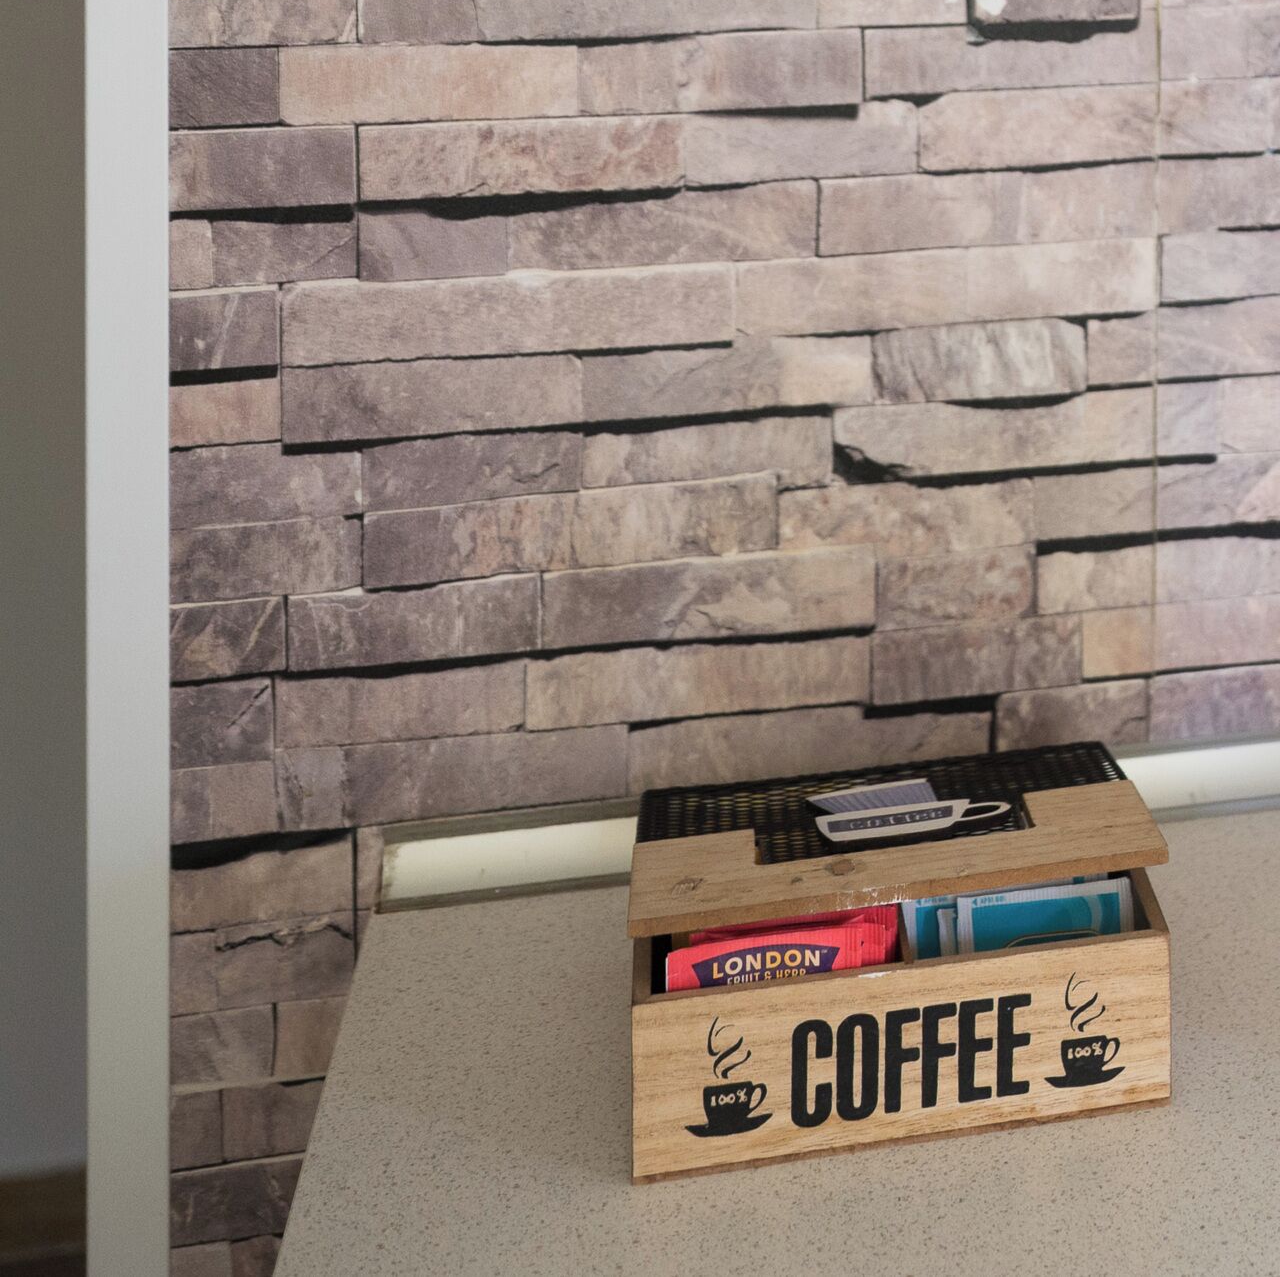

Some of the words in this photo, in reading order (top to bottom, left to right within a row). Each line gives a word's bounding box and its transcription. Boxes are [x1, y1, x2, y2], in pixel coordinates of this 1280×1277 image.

[712, 949, 821, 980] LONDON
[791, 993, 1032, 1128] COFFEE
[1067, 1041, 1103, 1059] 100%
[711, 1088, 748, 1107] 100%
